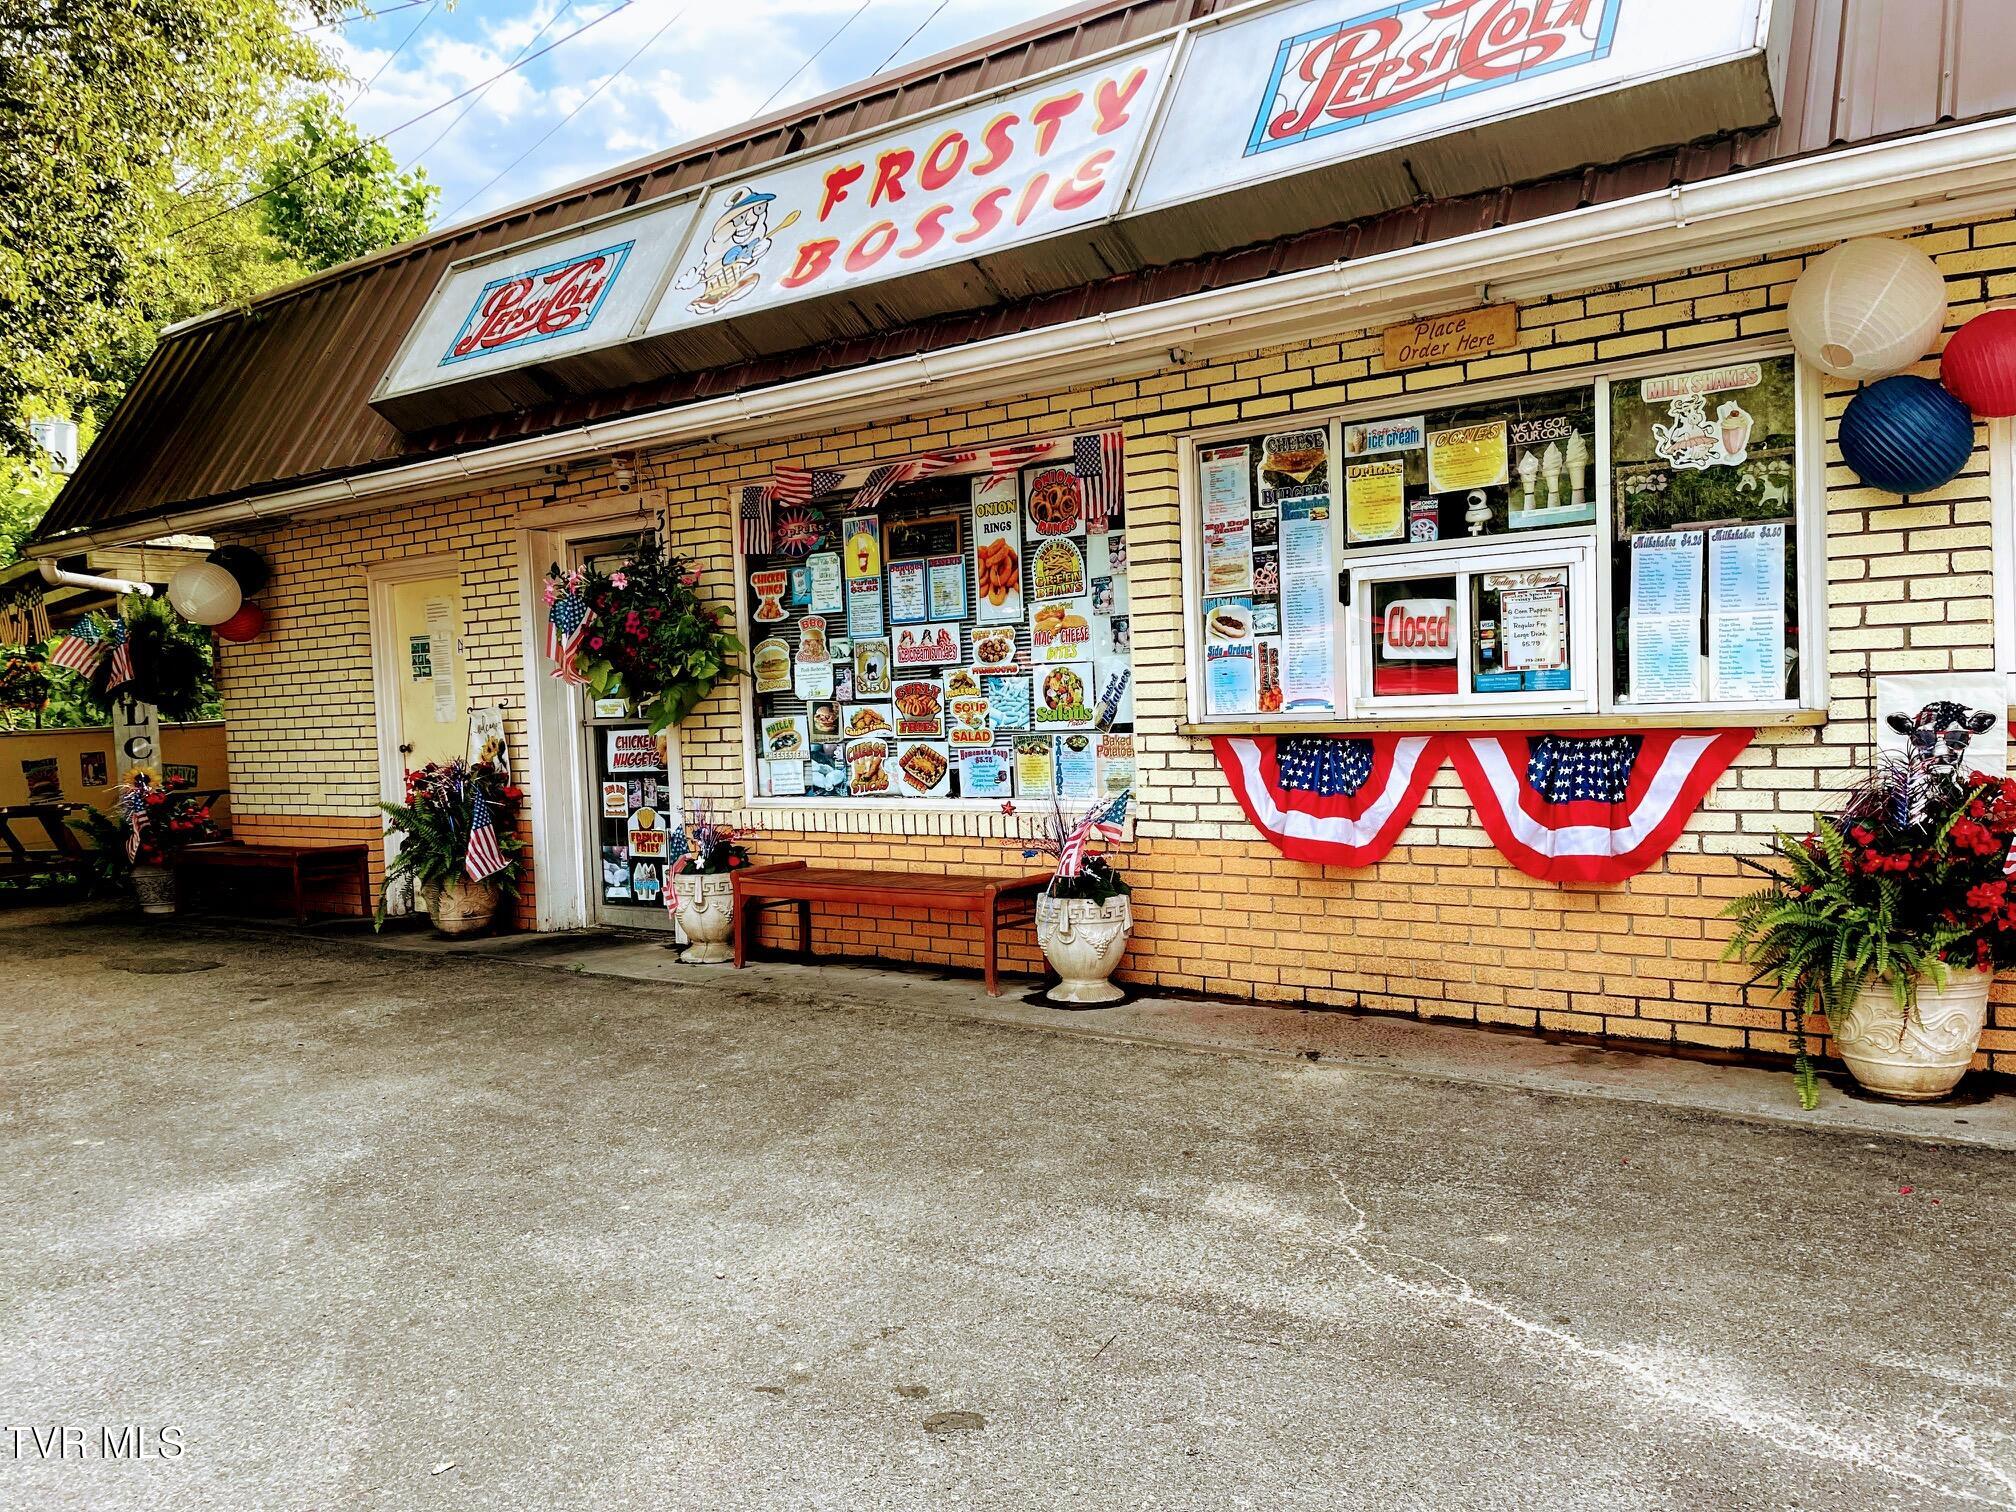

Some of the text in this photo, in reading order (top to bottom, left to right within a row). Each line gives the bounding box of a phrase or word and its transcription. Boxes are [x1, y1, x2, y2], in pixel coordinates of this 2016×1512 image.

[817, 67, 1148, 222] FROSTY
[778, 149, 1117, 289] BOSSIE
[1415, 318, 1466, 345] Place
[1399, 334, 1495, 362] Order Here
[1647, 364, 1759, 400] MILK SHAKES
[1510, 416, 1567, 433] WE'VE GOT
[1368, 429, 1420, 449] ice cream
[1435, 424, 1501, 447] CONES
[1511, 425, 1572, 443] YOUR CONE!
[1265, 432, 1324, 454] CHEESE
[1348, 462, 1403, 478] Drinks
[1032, 469, 1077, 492] ONION
[975, 500, 1017, 518] ONION
[983, 521, 1012, 534] RINGS
[1036, 515, 1078, 536] RINGS
[1633, 535, 1677, 549] Milkshakes
[1711, 527, 1756, 542] Milkshakes
[751, 573, 786, 584] CHICKEN
[1035, 571, 1083, 587] GREEN
[1526, 573, 1561, 586] Special
[756, 584, 784, 596] WINGS
[1035, 581, 1084, 598] BEANS
[800, 617, 825, 632] BBQ
[1388, 605, 1450, 648] Closed
[1033, 627, 1089, 646] MAC CHEESE
[1046, 644, 1078, 660] BITES
[1207, 644, 1253, 657] Side Orders
[894, 682, 942, 699] CURLY
[1101, 673, 1119, 704] Baked
[1101, 669, 1132, 725] Potatoes
[953, 701, 987, 714] SOUP
[1035, 702, 1093, 722] Salads
[766, 718, 795, 734] PHILLY
[899, 722, 939, 734] FRIES
[615, 734, 657, 750] CHICKEN
[951, 730, 992, 743] SALAD
[1102, 734, 1132, 746] Baked
[613, 751, 661, 768] NUGGETS
[765, 750, 809, 760] CHEESESTEAK
[847, 741, 887, 763] CHEESE
[960, 749, 1009, 762] Homemade Soup
[1055, 735, 1063, 796] SALADS
[850, 774, 890, 794] STICKS
[629, 832, 664, 843] FRENCH
[635, 842, 660, 853] FRIES
